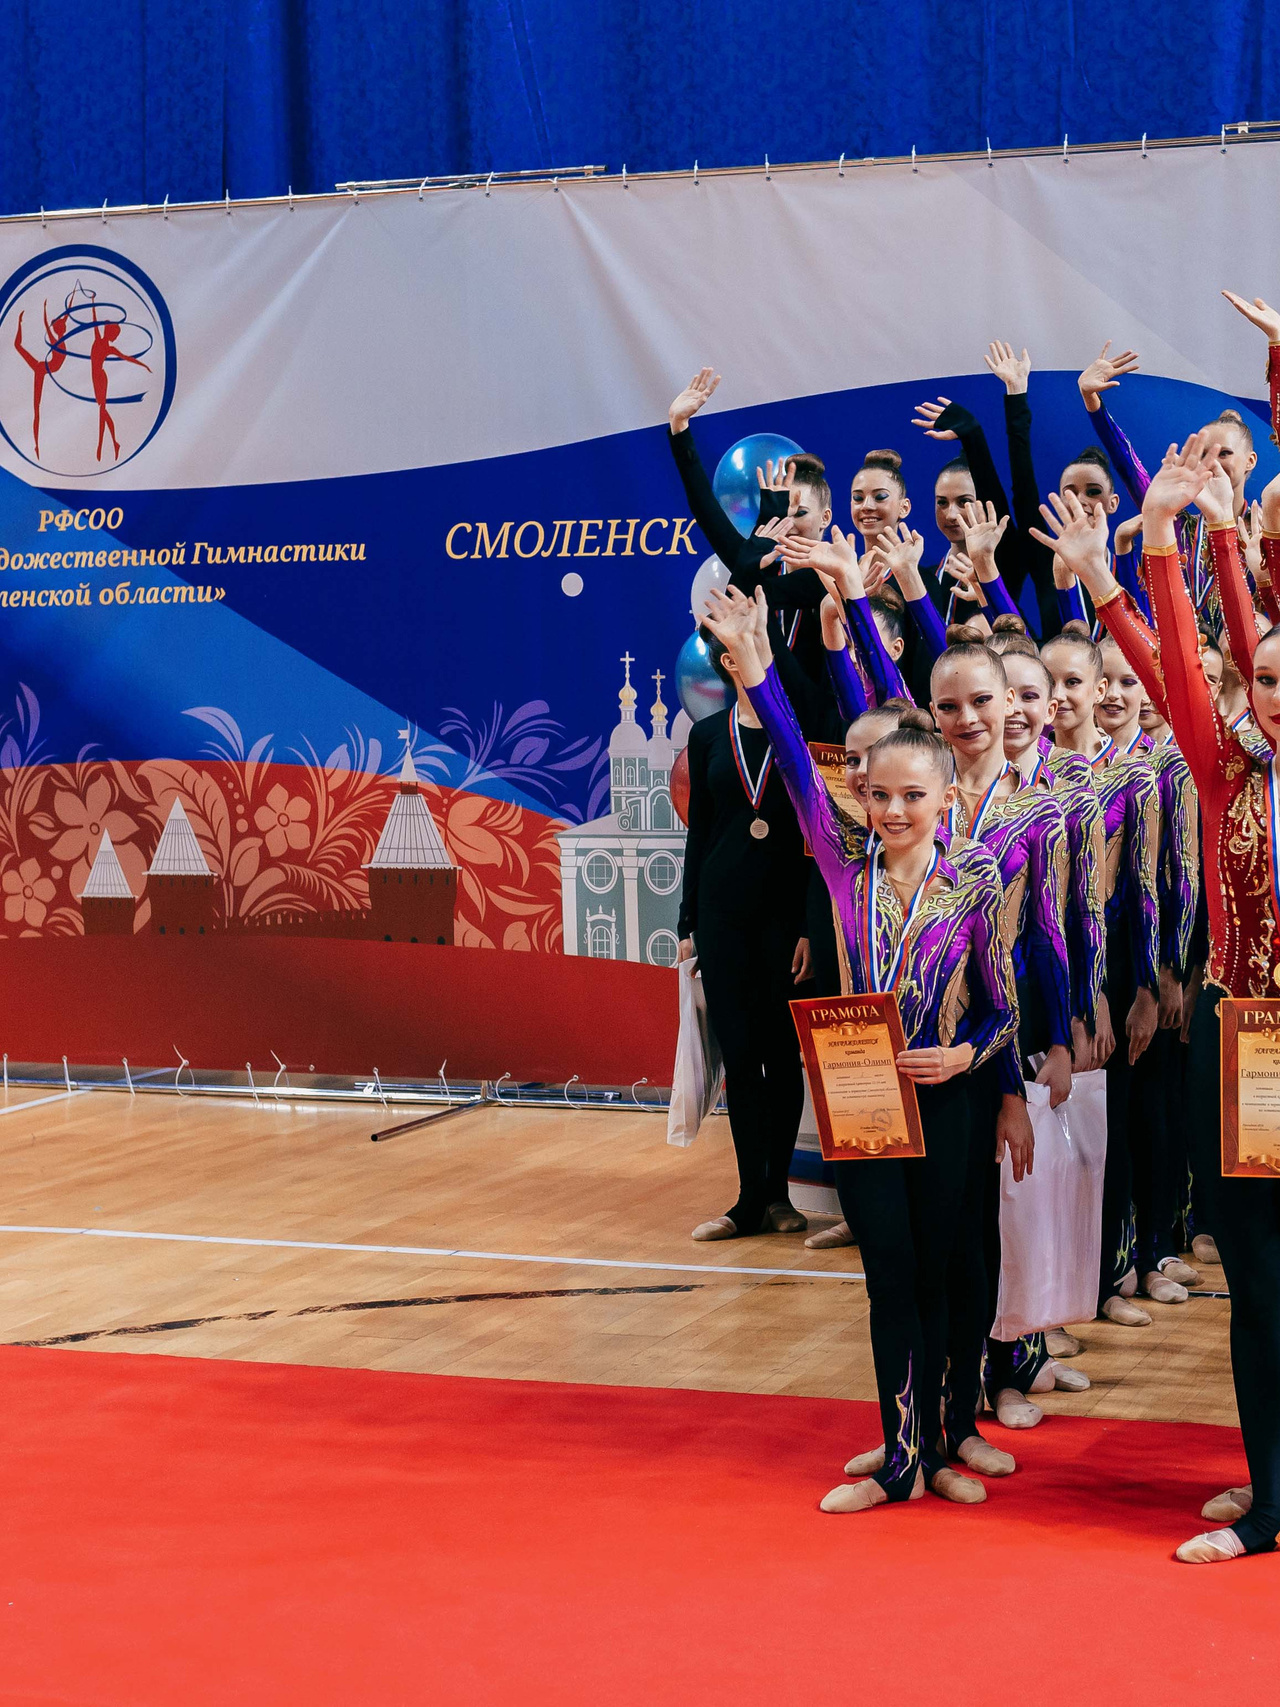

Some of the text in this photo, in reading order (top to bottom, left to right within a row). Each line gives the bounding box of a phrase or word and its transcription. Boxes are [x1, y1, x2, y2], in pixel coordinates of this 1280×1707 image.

[37, 507, 125, 533] РФСОО
[445, 518, 697, 559] СМОЛЕНСК
[190, 542, 366, 566] Гимнастики
[98, 581, 226, 606] области»
[821, 751, 847, 763] ГРАМ
[811, 1004, 880, 1022] ГРАМОТА
